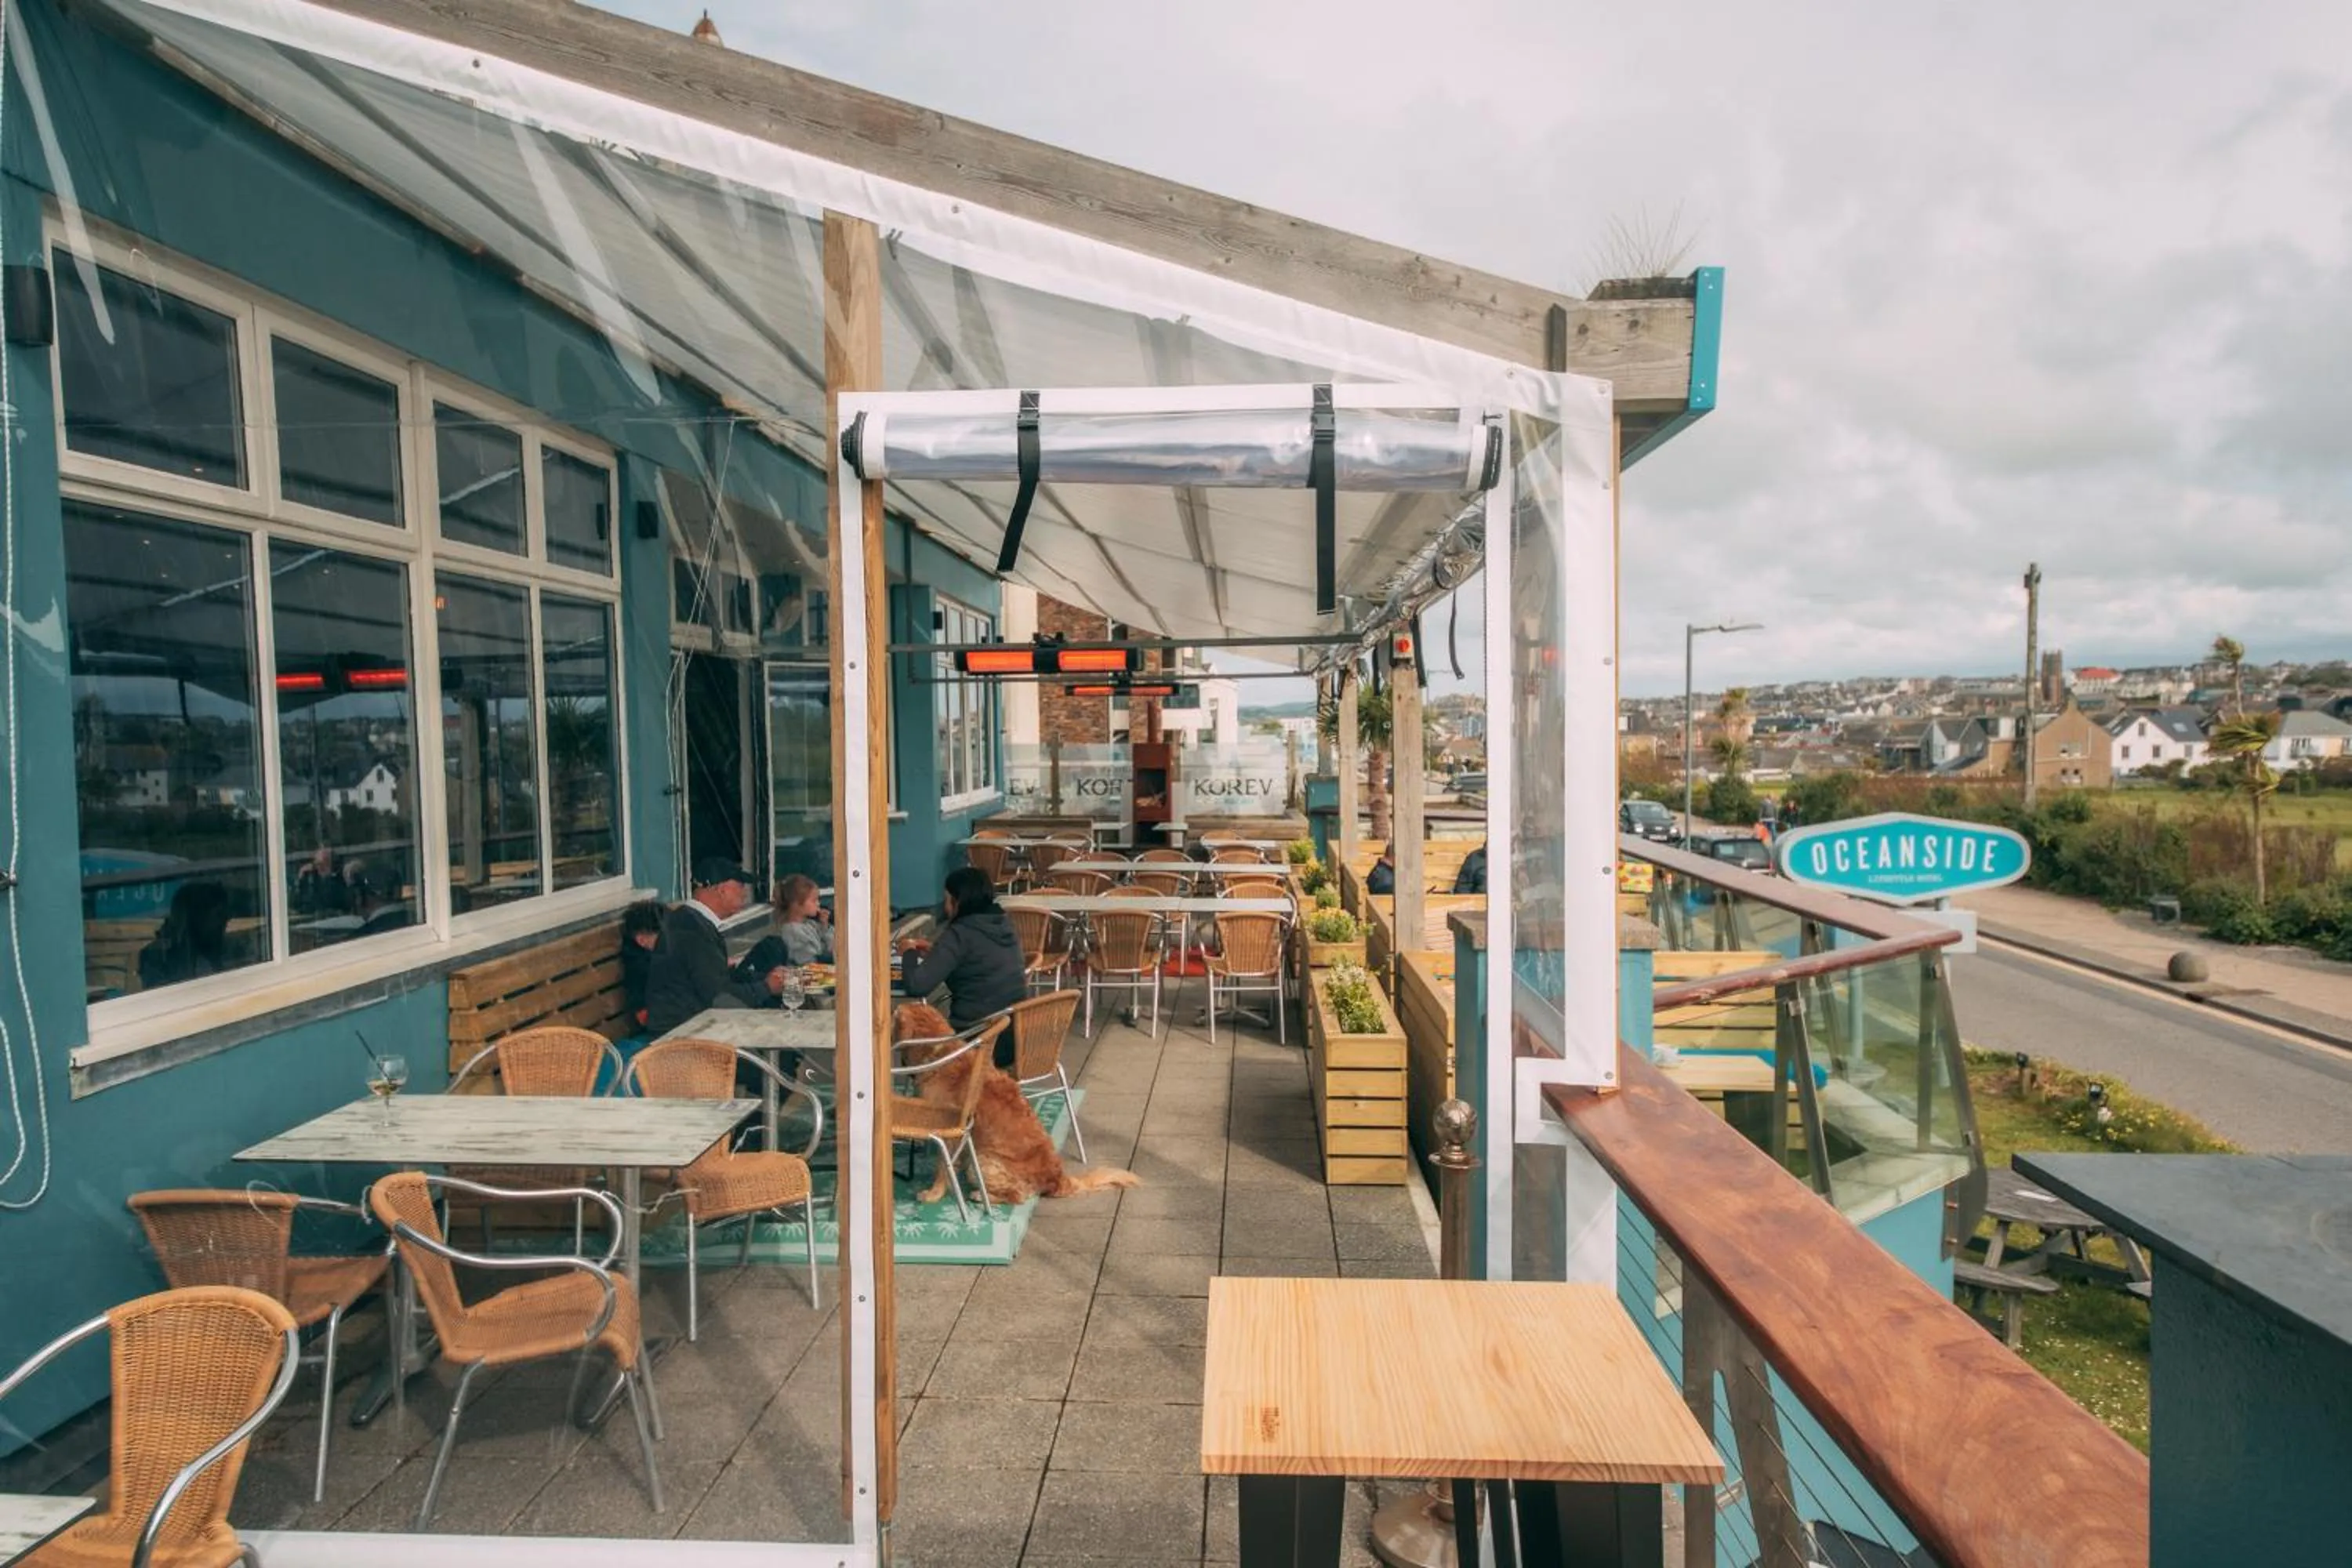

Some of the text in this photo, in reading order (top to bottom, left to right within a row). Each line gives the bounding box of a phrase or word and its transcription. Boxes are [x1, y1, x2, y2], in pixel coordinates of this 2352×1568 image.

[1076, 779, 1134, 796] KOR
[1194, 779, 1272, 796] KOREV
[1812, 835, 1998, 875] OCEANSIDE
